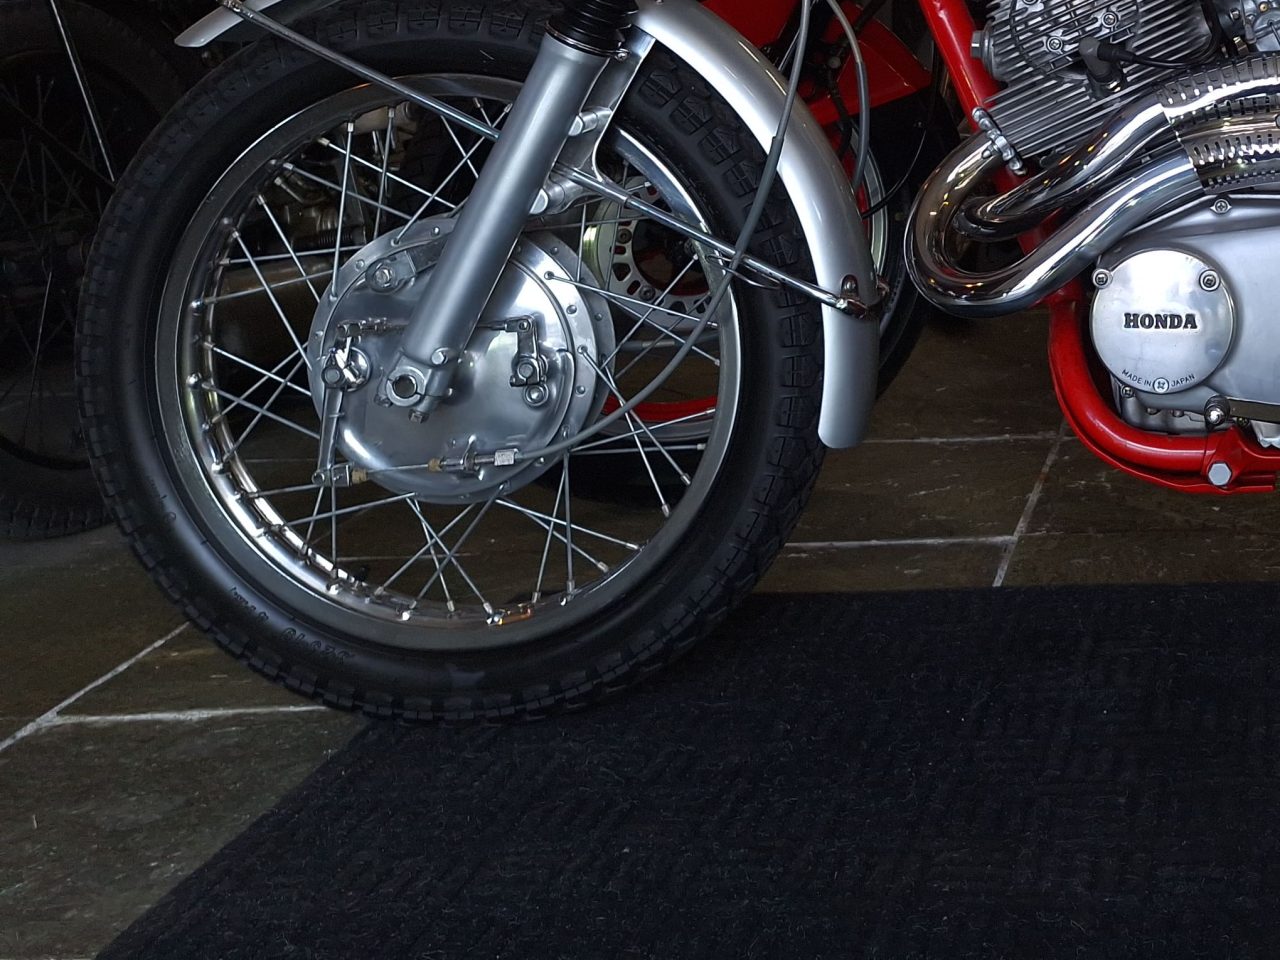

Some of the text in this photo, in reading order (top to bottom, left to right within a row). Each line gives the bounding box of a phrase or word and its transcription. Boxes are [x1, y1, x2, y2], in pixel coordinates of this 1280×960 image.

[1124, 313, 1198, 329] HONDA
[1121, 369, 1195, 387] MADE IN JAPAN
